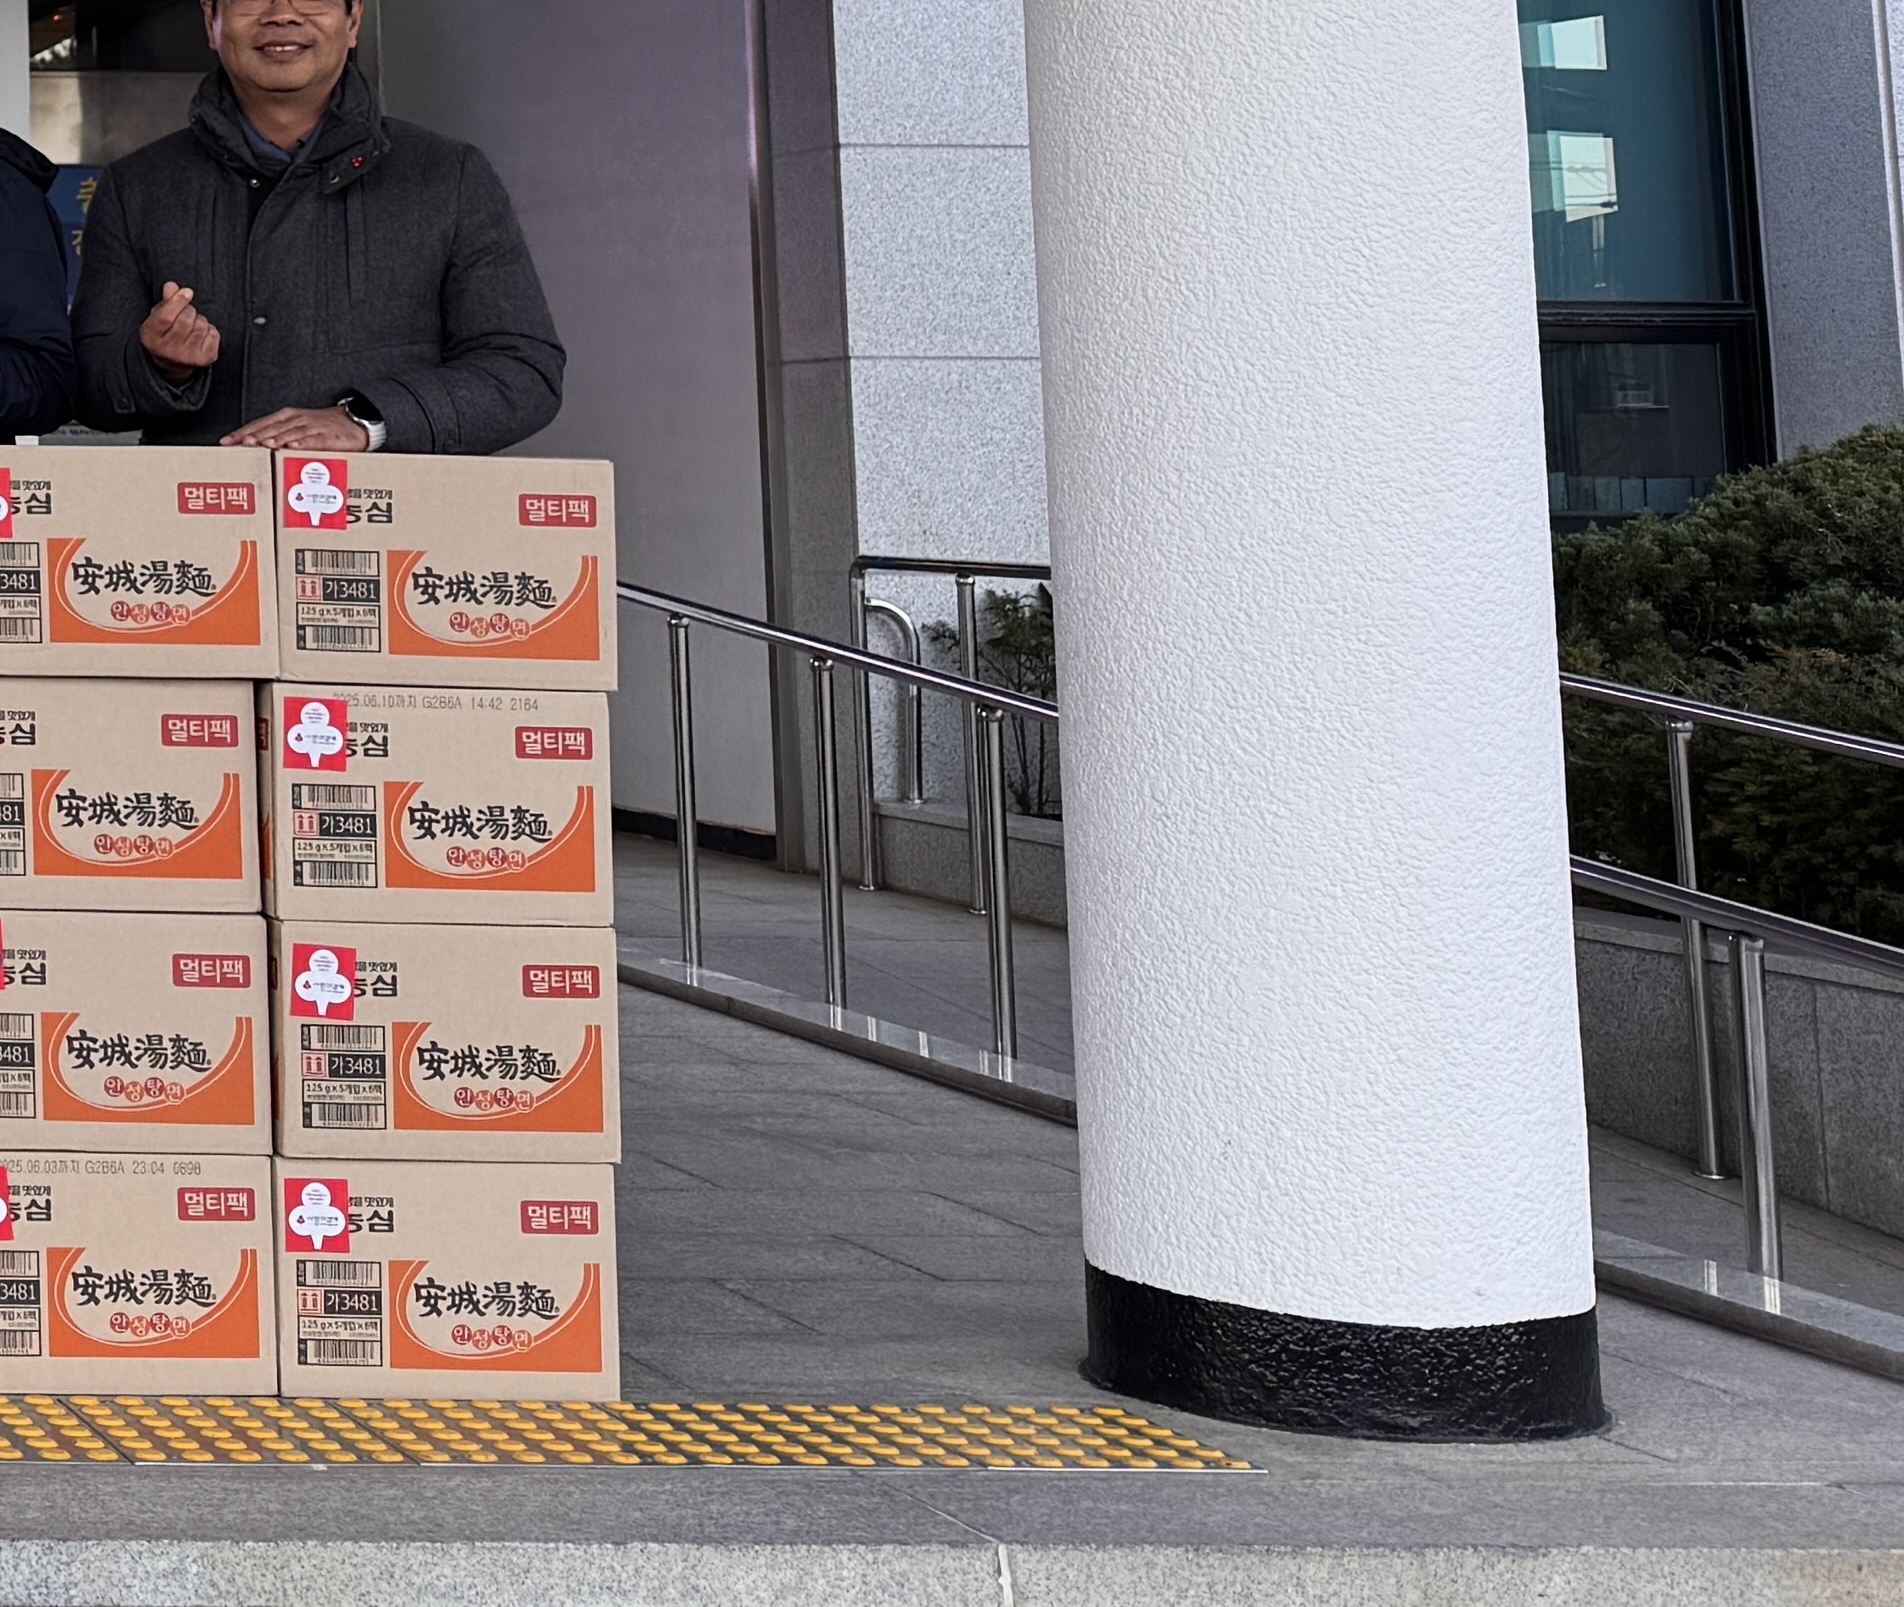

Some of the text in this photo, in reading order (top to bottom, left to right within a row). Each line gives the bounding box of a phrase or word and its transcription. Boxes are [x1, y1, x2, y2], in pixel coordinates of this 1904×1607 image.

[184, 486, 248, 511] 멀티팩
[526, 499, 590, 523] 멀티팩
[325, 581, 376, 600] 가3481
[112, 603, 190, 623] 안성탕면
[452, 614, 530, 634] 안성탕면
[168, 719, 231, 743] 멀티팩
[522, 731, 586, 756] 멀티팩
[322, 816, 372, 835] 가3481
[96, 835, 173, 856] 안성탕면
[448, 848, 525, 869] 안성탕면
[179, 959, 244, 984] 멀티팩
[530, 970, 593, 995] 멀티팩
[331, 1056, 381, 1076] 가3481
[107, 1078, 184, 1099] 안성탕면
[457, 1088, 534, 1109] 안성탕면
[183, 1194, 247, 1219] 멀티팩
[527, 1205, 592, 1231] 멀티팩
[326, 1293, 377, 1313] 가3481
[112, 1314, 190, 1335] 안성탕면
[454, 1326, 532, 1348] 안성탕면
